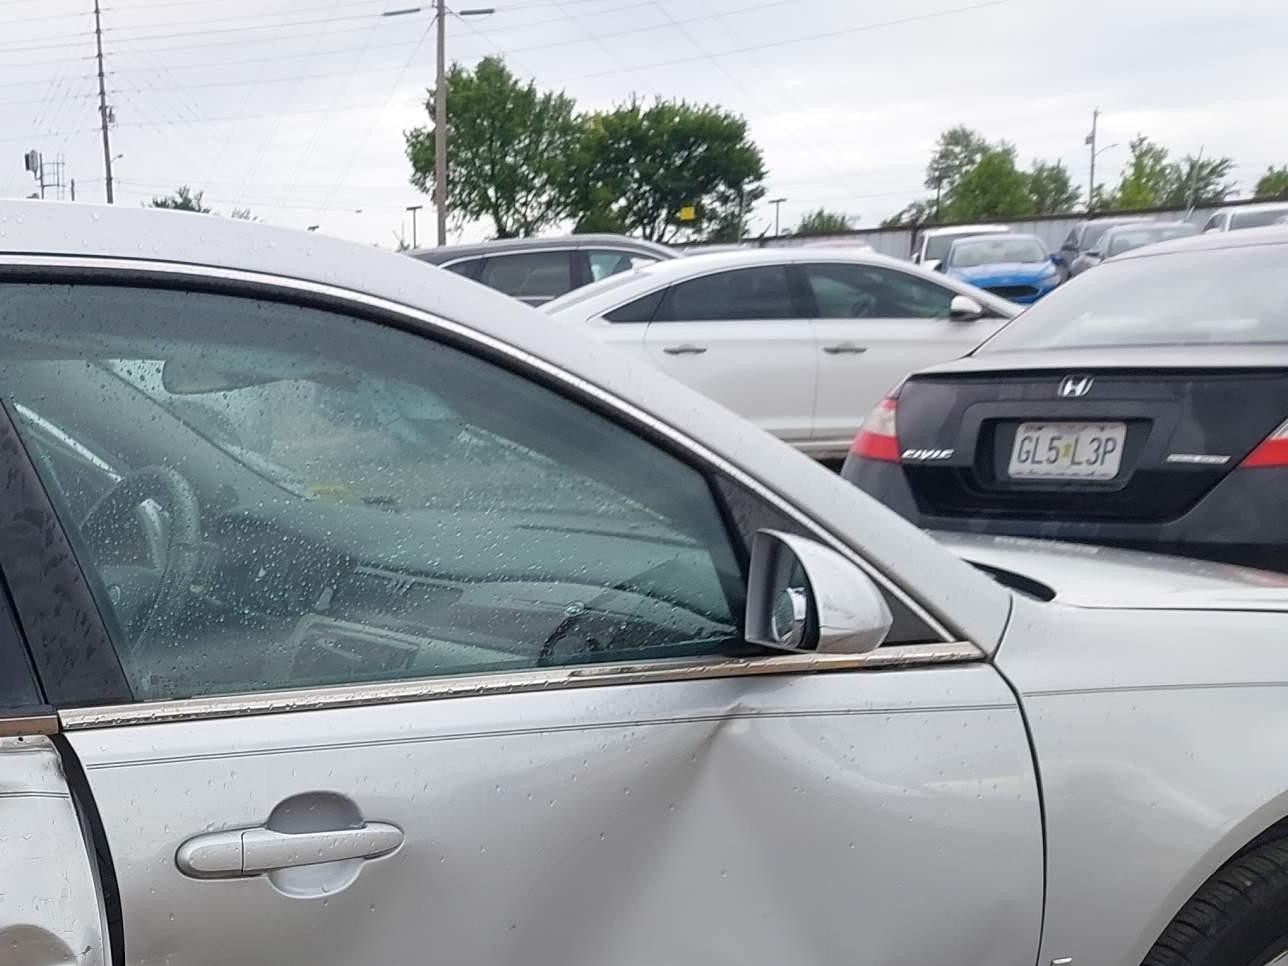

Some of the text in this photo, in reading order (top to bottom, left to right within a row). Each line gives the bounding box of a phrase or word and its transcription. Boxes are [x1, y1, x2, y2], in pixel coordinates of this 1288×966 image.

[901, 448, 955, 467] CIVIC
[1017, 436, 1117, 466] GL5 L3P
